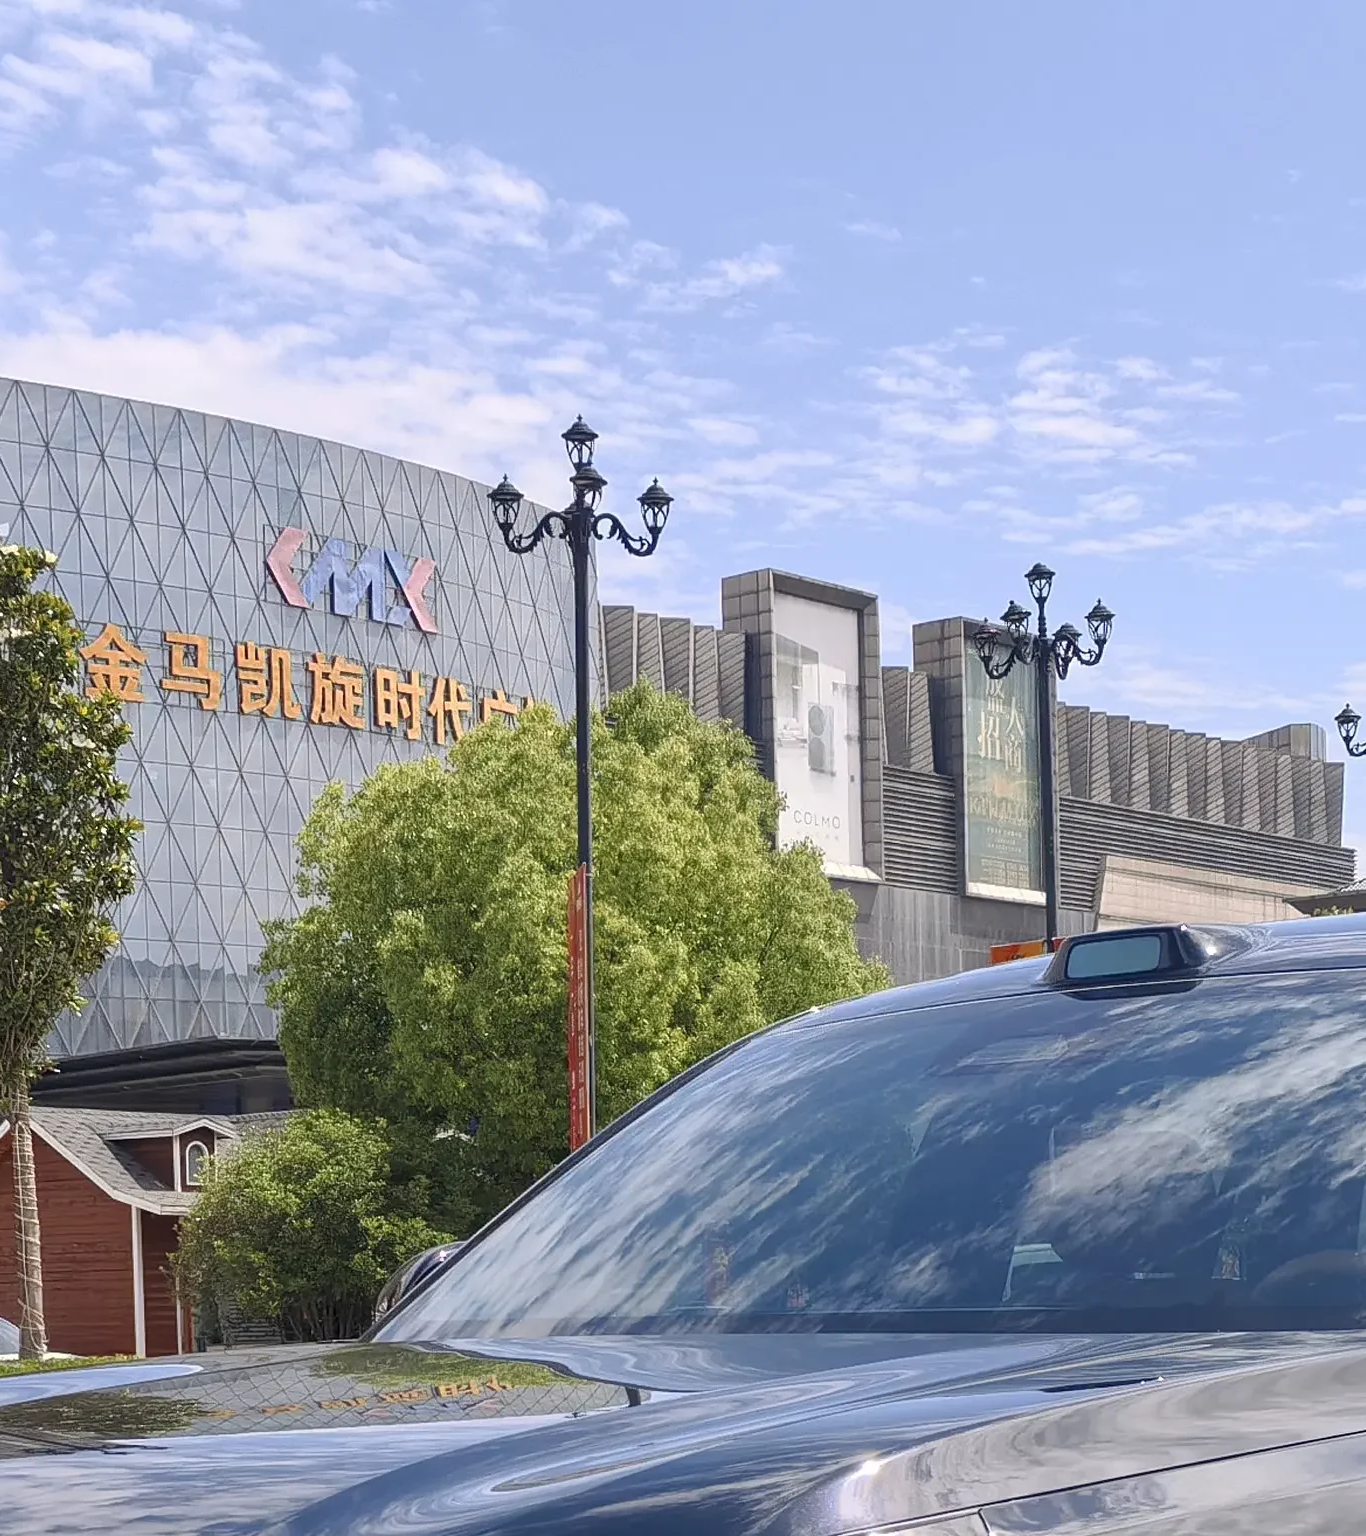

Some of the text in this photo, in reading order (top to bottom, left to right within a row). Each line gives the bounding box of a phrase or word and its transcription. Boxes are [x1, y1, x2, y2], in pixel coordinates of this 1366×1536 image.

[81, 624, 535, 746] 金马凯旋时代广
[793, 810, 841, 829] COLMO
